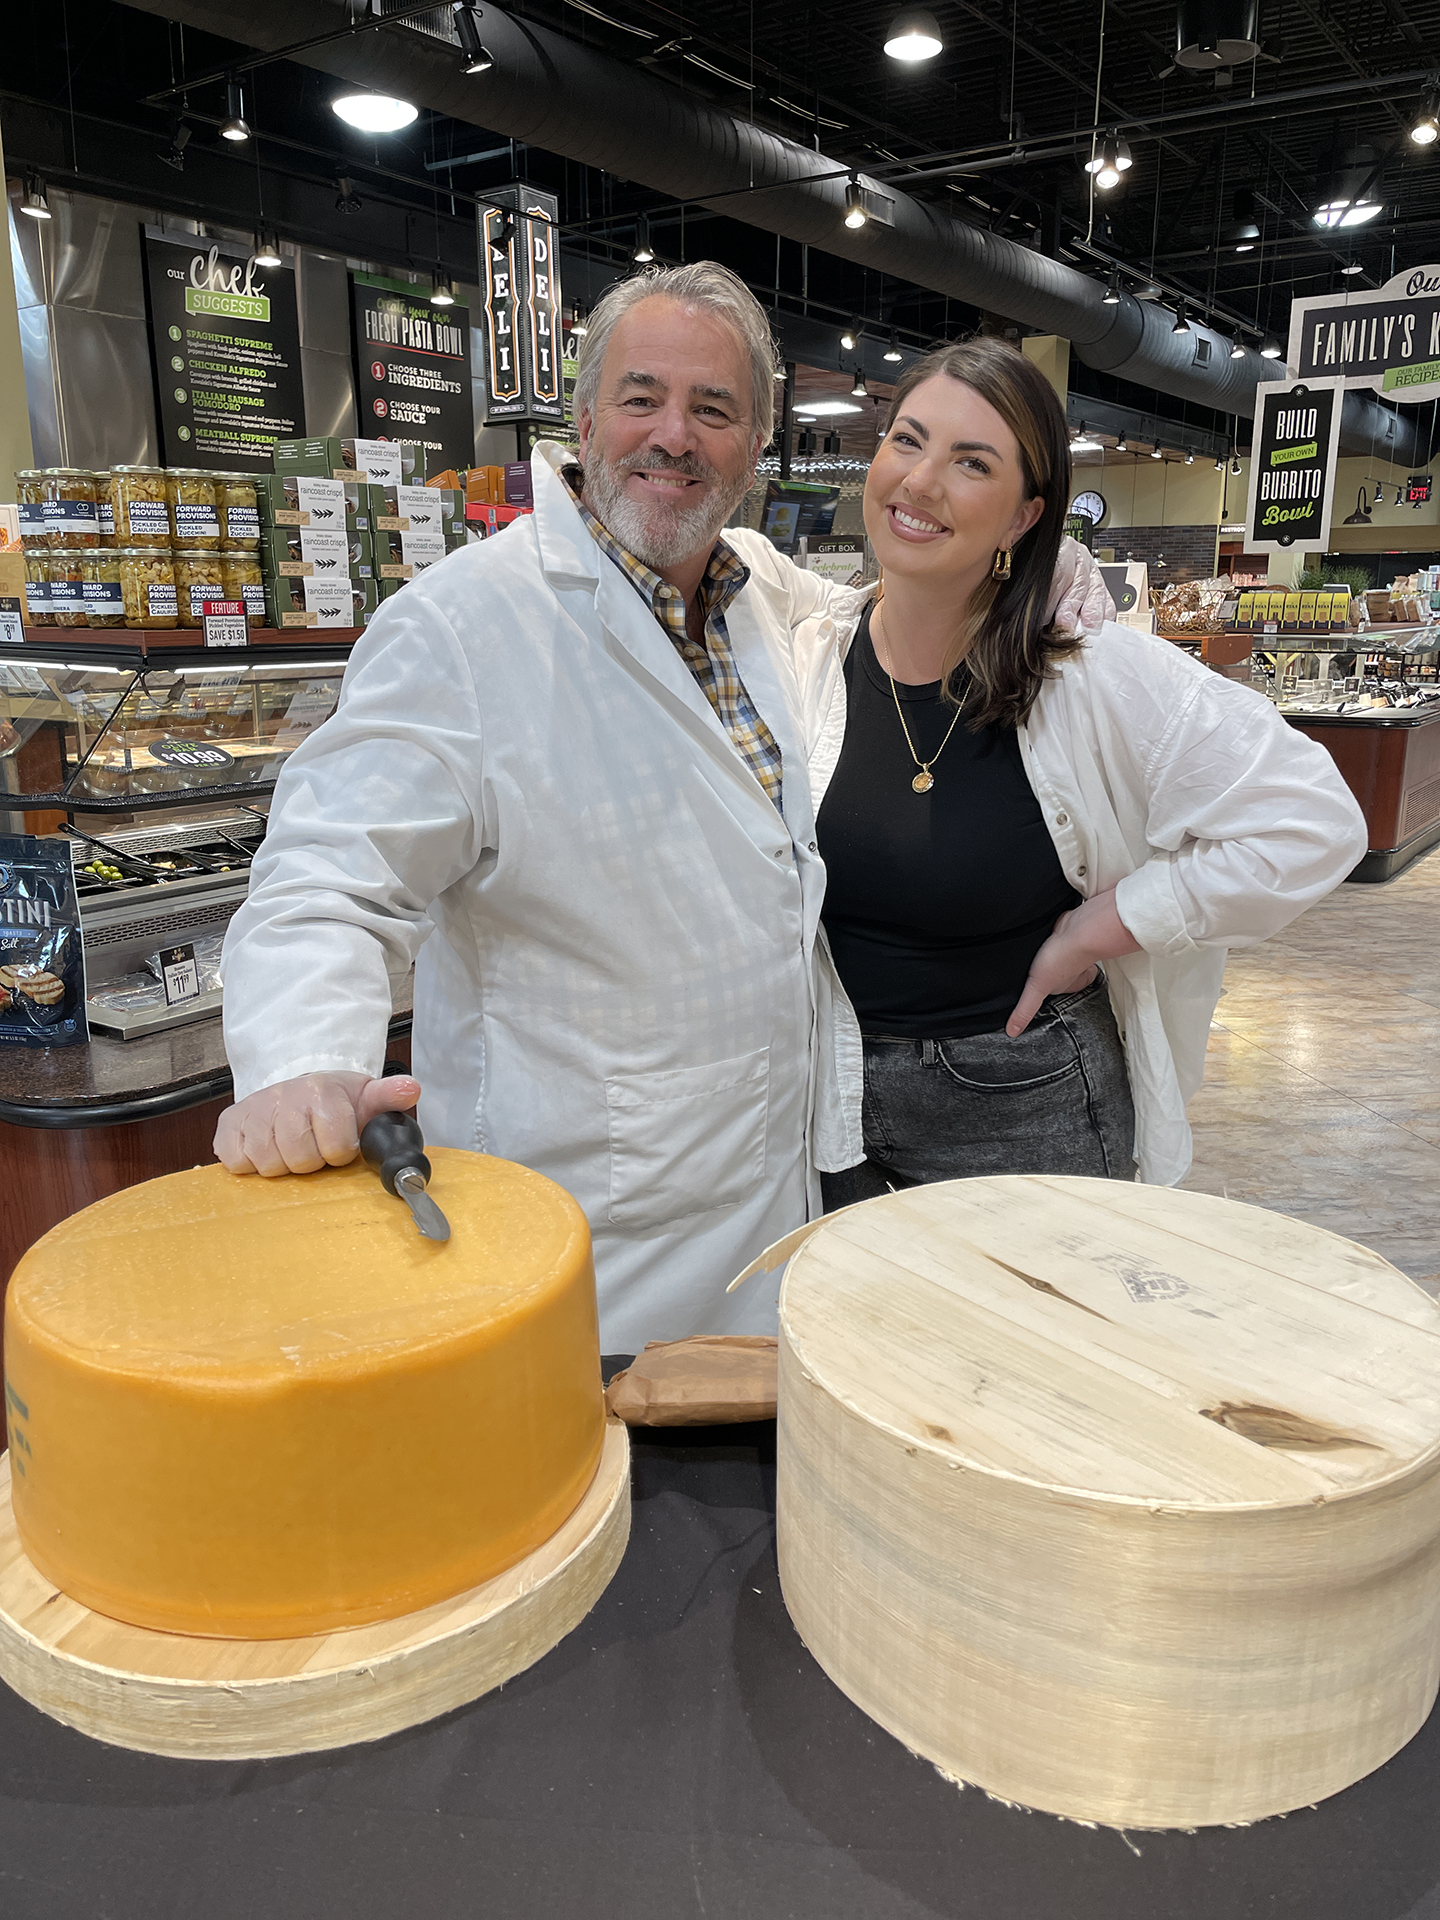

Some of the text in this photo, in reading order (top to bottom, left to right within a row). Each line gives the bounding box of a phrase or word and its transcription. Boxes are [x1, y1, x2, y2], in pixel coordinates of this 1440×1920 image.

[167, 268, 185, 280] our
[193, 294, 262, 316] SUGGESTS
[534, 237, 550, 372] DELI
[408, 306, 430, 323] your
[432, 313, 452, 325] own
[365, 309, 464, 356] FRESH PASTA BOWL
[186, 329, 233, 345] SPAGHETTI
[234, 337, 273, 351] SUPREME
[1312, 313, 1416, 367] FAMILY'S
[188, 359, 227, 373] CHICKEN
[228, 365, 266, 378] ALFREDO
[375, 363, 442, 379] 1 CHOOSE THREE
[1397, 366, 1413, 375] OUR
[388, 371, 462, 394] INGREDIENTS
[191, 390, 226, 402] ITALIAN
[227, 395, 265, 407] SAUSAGE
[193, 399, 241, 411] POMODORO
[376, 400, 441, 415] 2 CHOOSE YOUR
[390, 409, 426, 425] SAUCE
[1275, 408, 1318, 440] BUILD
[195, 428, 239, 440] MEATBALL
[423, 440, 443, 450] YOUR
[358, 448, 399, 459] raincoast crisps
[1273, 447, 1315, 462] YOUR OWN
[1261, 468, 1322, 501] BURRITO
[301, 486, 343, 498] raincoast crisps
[400, 494, 440, 504] raincoast crisps
[1409, 487, 1428, 501] EXIT
[1262, 501, 1315, 526] Bowl
[304, 537, 347, 547] raincoast crisps
[404, 542, 443, 551] raincoast crisps
[818, 544, 856, 553] GIFT BOX
[812, 562, 857, 571] celebrate
[307, 587, 351, 596] raincoast crisps
[211, 602, 240, 614] FEATURE
[209, 629, 245, 640] SAVE $1.50
[161, 742, 198, 750] OLIVE
[161, 750, 227, 765] $10.99
[0, 898, 50, 928] TINI
[1, 937, 19, 950] Salt
